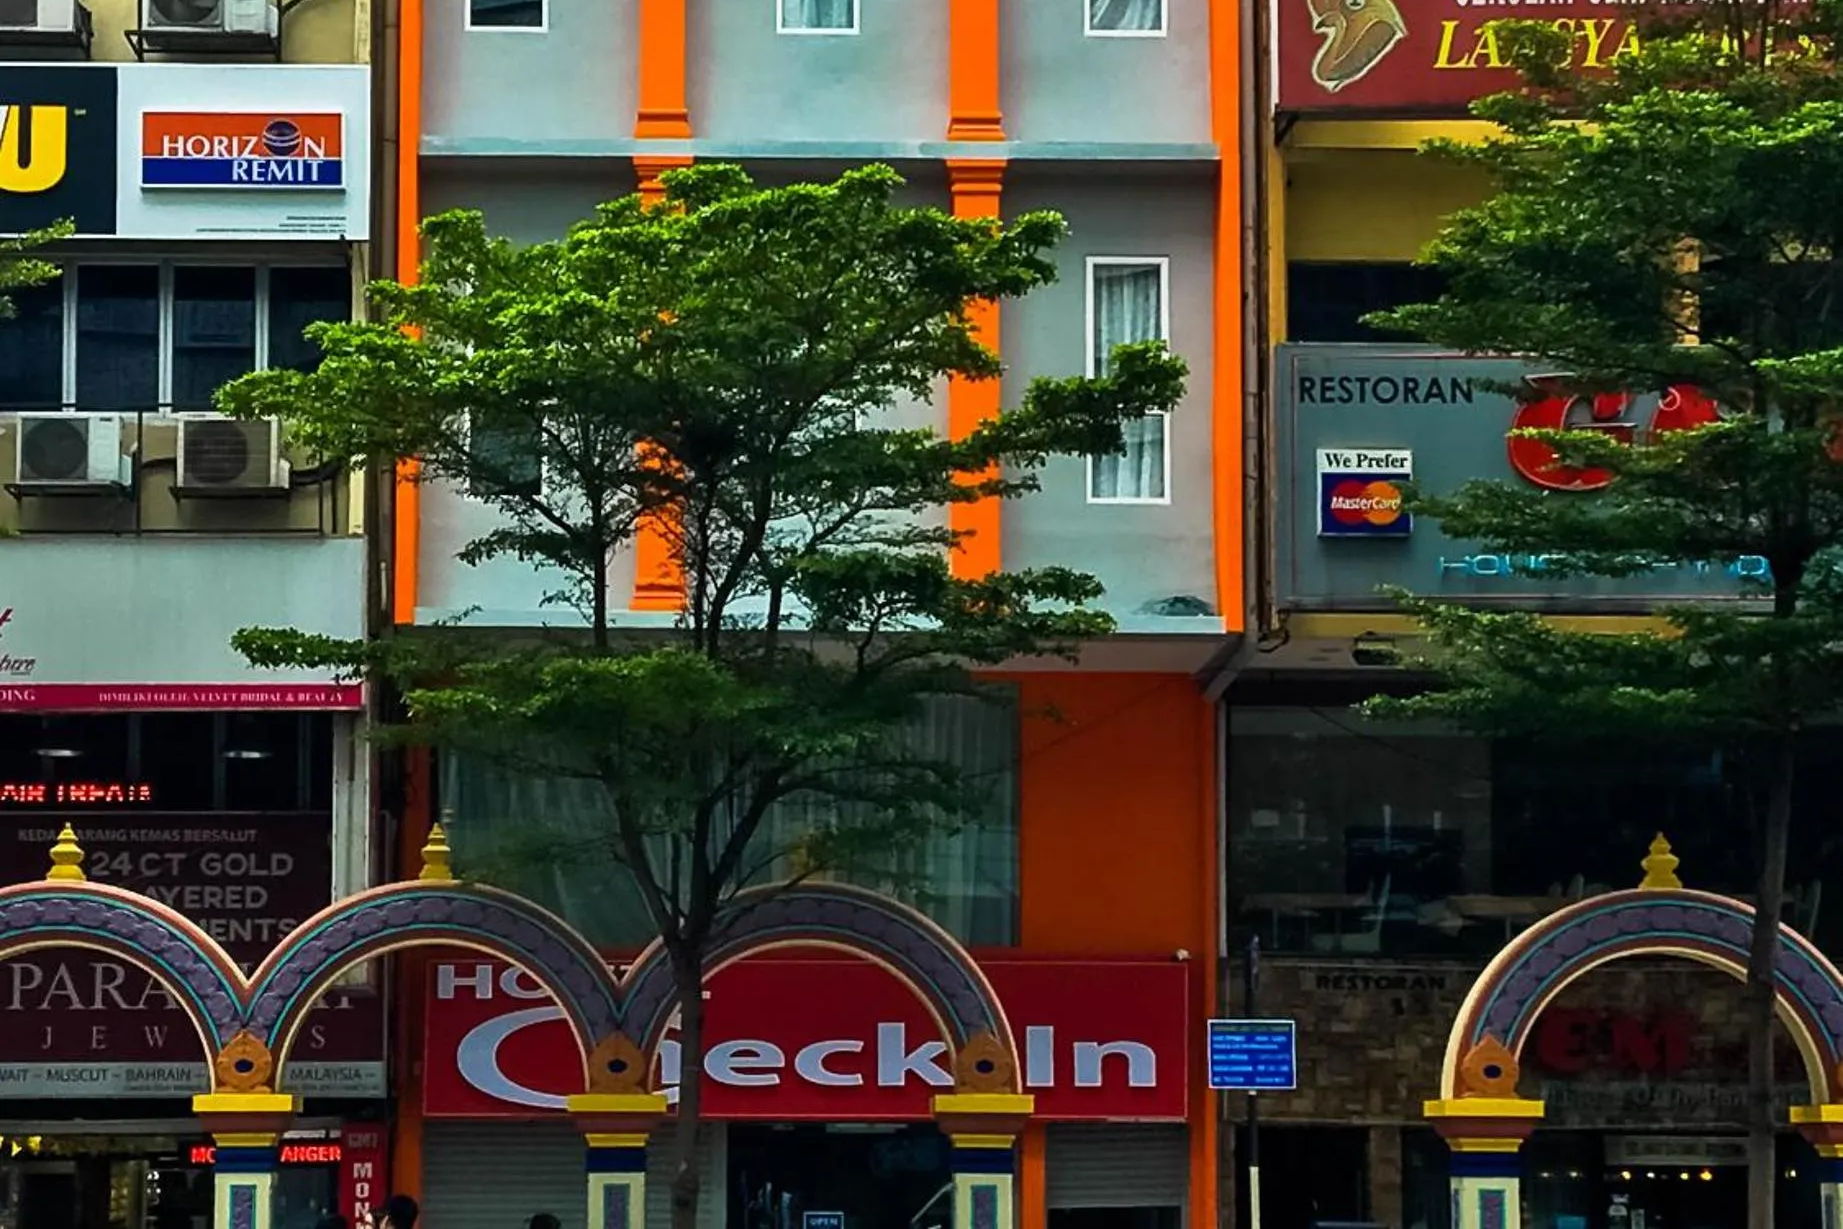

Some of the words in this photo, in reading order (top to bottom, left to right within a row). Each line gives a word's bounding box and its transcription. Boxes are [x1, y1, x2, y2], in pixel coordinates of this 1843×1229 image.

[232, 160, 323, 181] REMIT
[1299, 376, 1473, 404] RESTORAN
[1325, 453, 1351, 468] We
[1356, 453, 1408, 468] Prefer
[17, 829, 55, 842] KEDA
[78, 829, 127, 842] ARANG
[130, 829, 181, 842] KEMAS
[184, 829, 258, 843] BERSALUT
[90, 852, 133, 876] 24
[139, 853, 188, 876] CT
[199, 853, 294, 876] GOLD
[145, 886, 268, 909] AYERED
[1316, 975, 1446, 990] RESTORAN
[1026, 1025, 1157, 1088] In
[126, 1068, 191, 1081] BAHRAIN
[289, 1068, 363, 1081] MALAYSIA
[280, 1146, 341, 1162] ANGER
